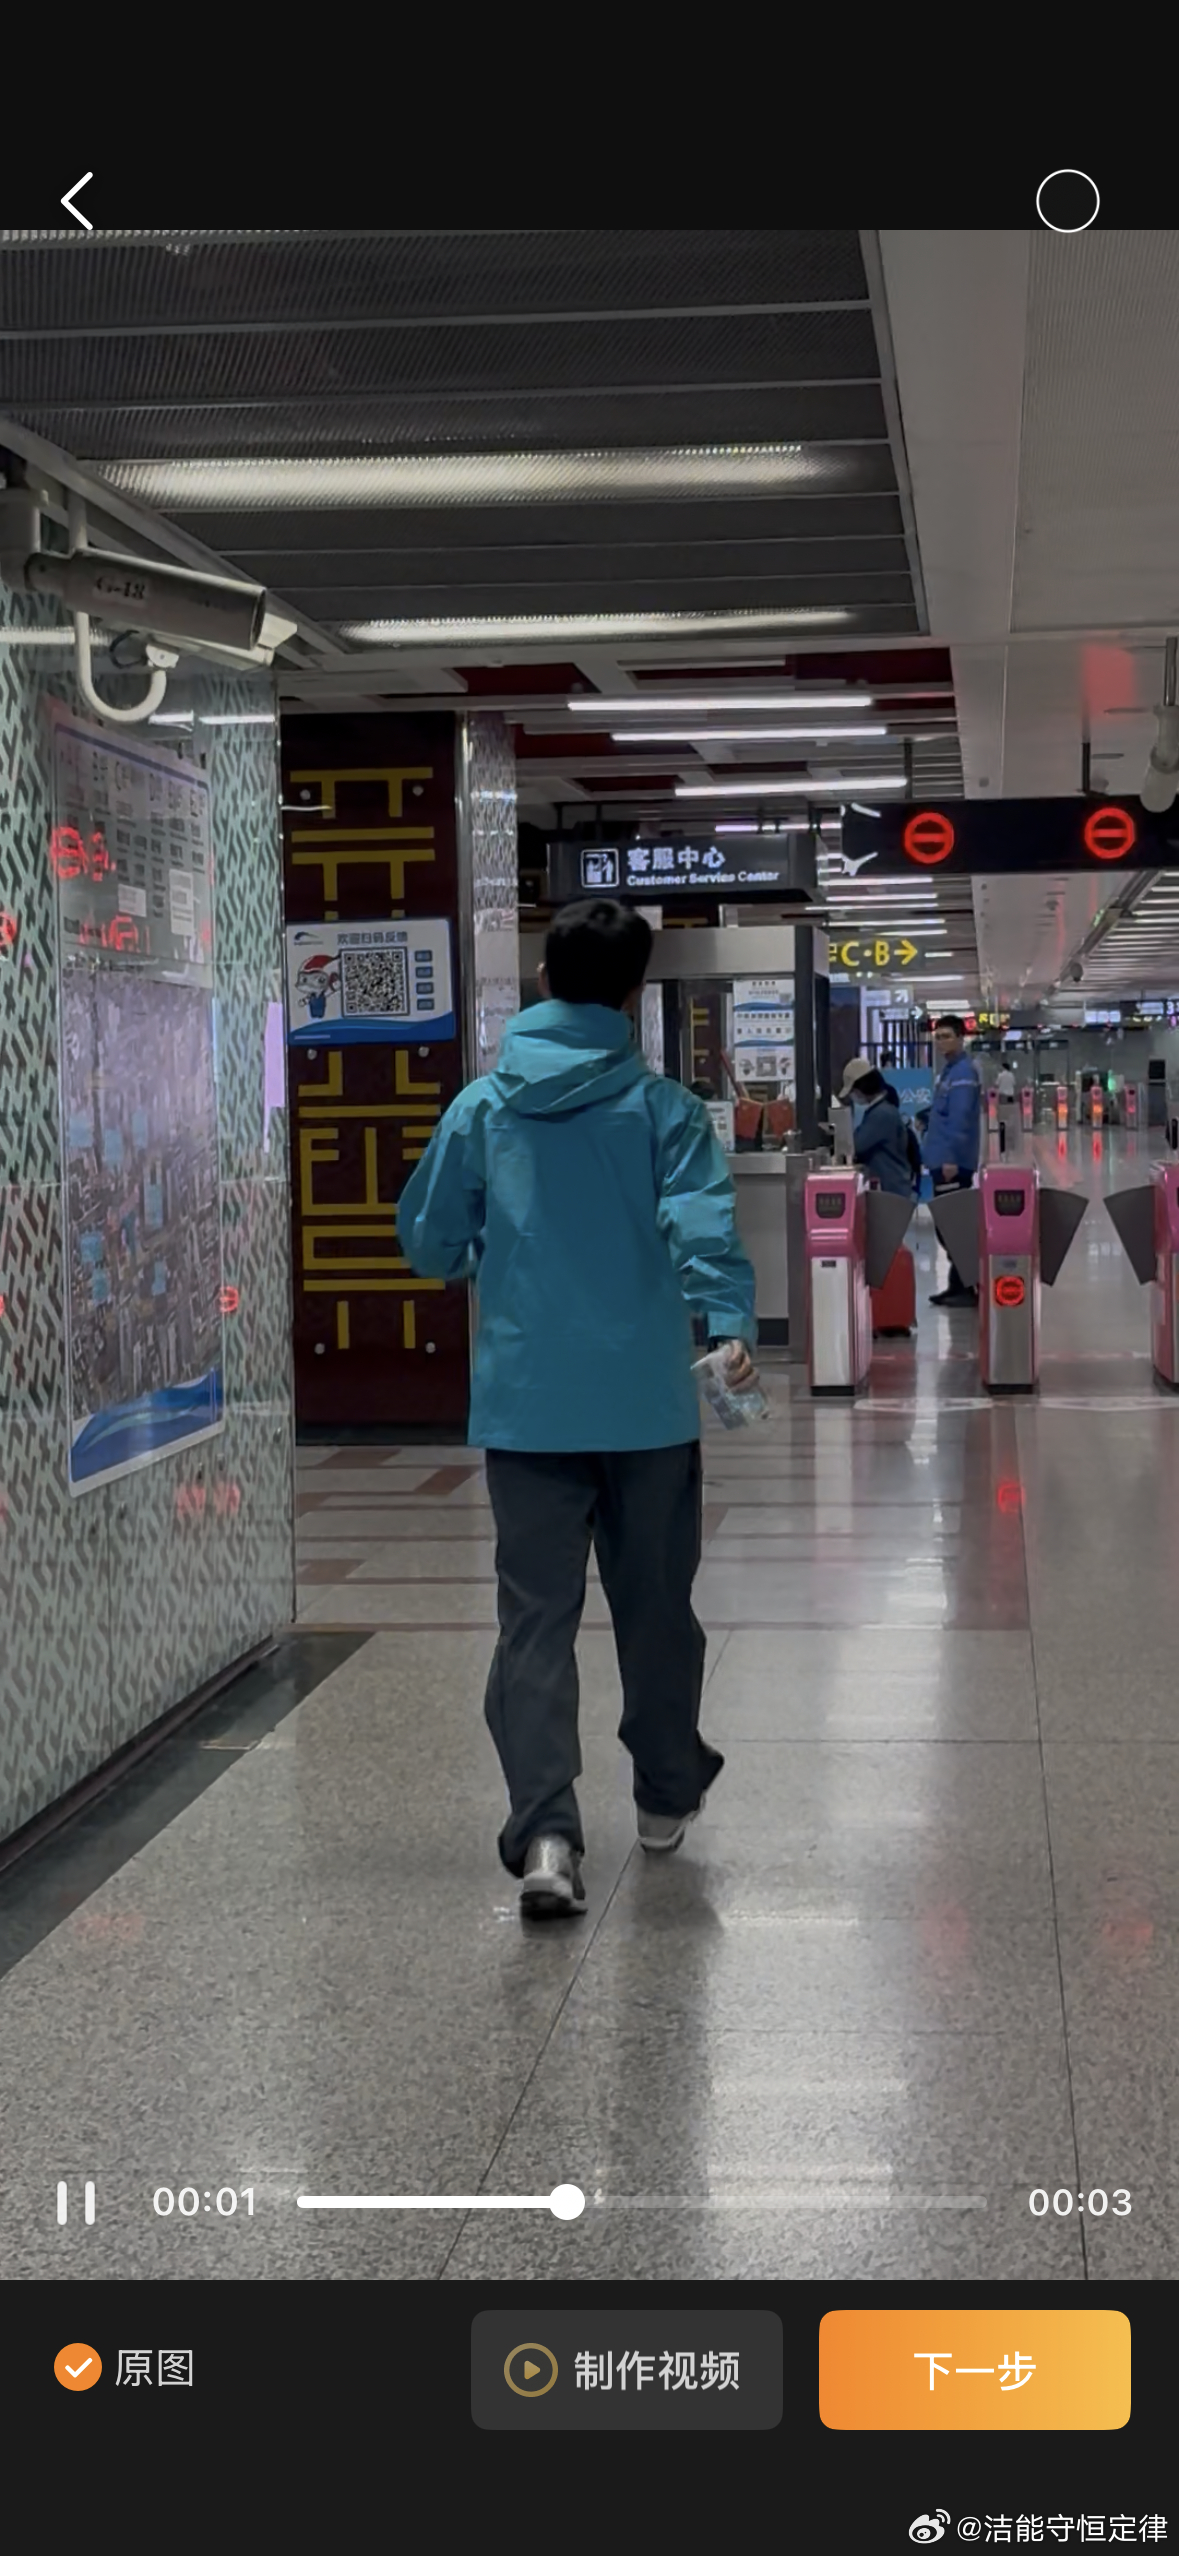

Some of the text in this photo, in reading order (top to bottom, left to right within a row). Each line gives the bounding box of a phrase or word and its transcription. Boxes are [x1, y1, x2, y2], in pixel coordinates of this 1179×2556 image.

[627, 846, 725, 871] 客服中心
[627, 871, 779, 886] Customer Service Center
